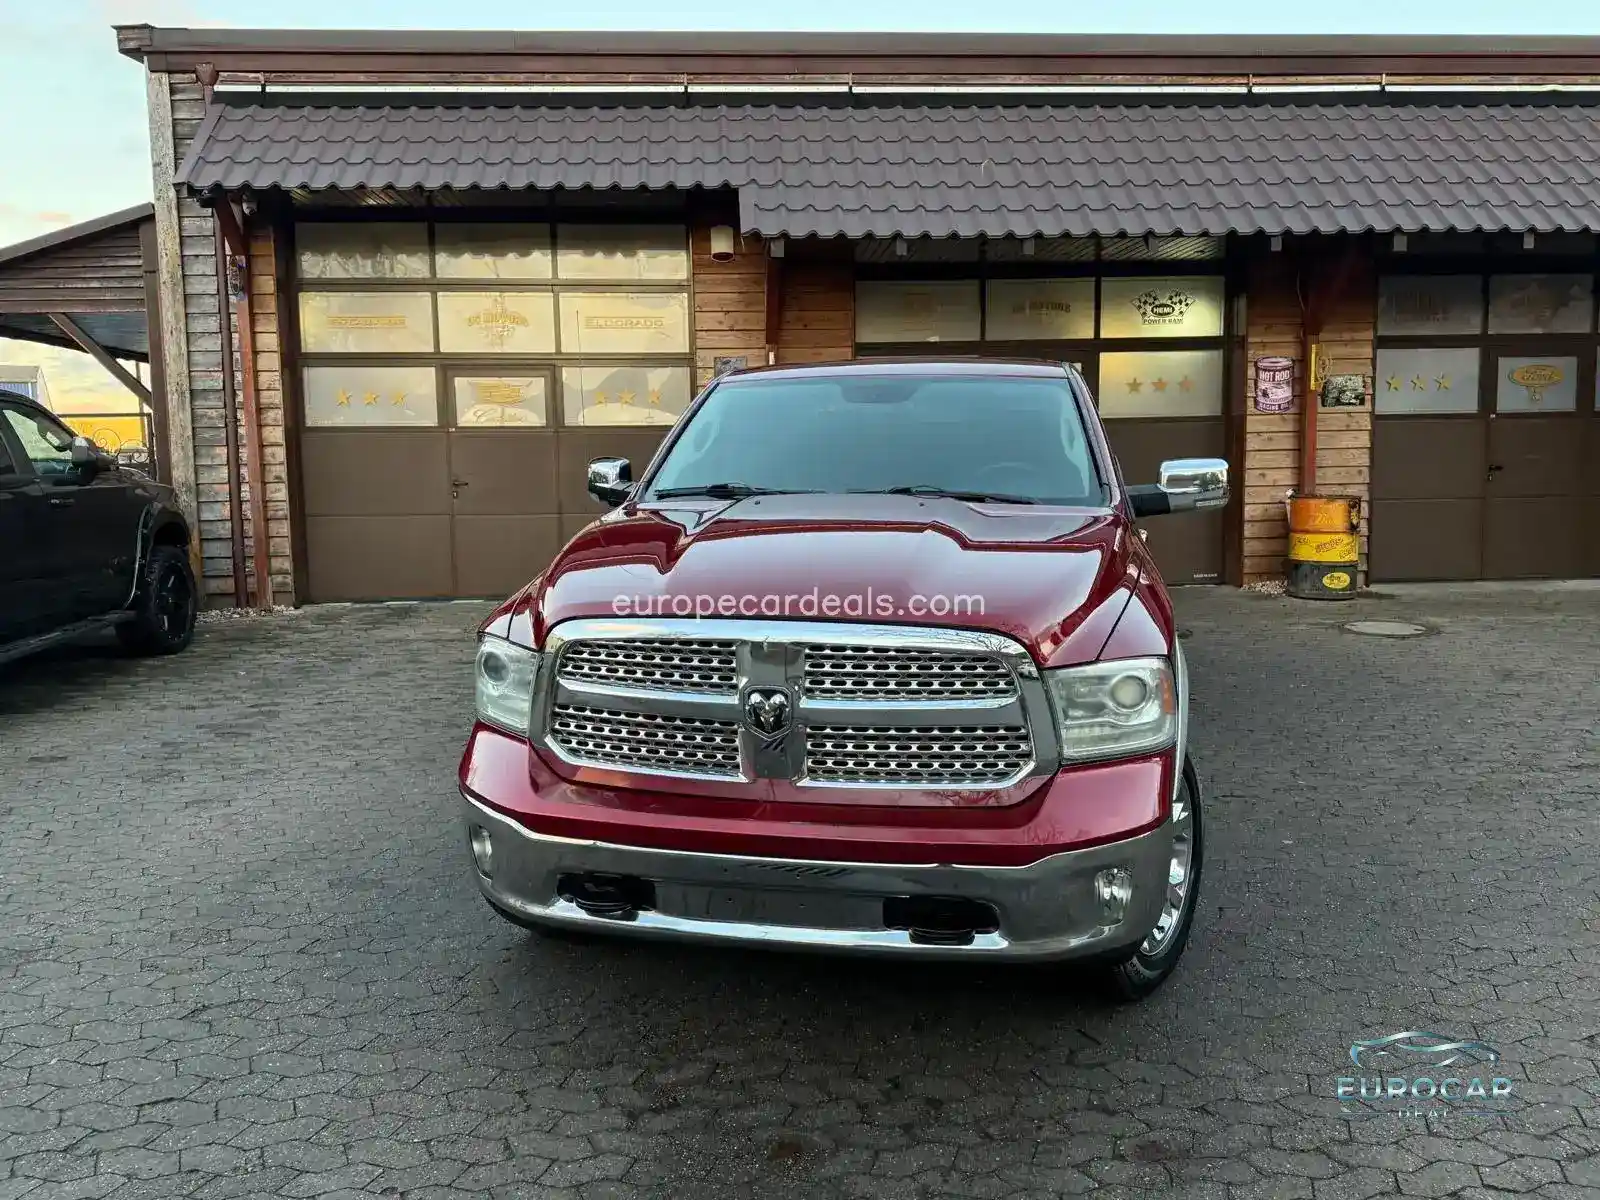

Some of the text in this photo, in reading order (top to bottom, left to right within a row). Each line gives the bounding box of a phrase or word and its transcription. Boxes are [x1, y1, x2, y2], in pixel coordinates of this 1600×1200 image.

[1152, 306, 1173, 315] HEMI
[585, 318, 664, 328] ELDORADO
[1260, 370, 1290, 381] HOT ROD
